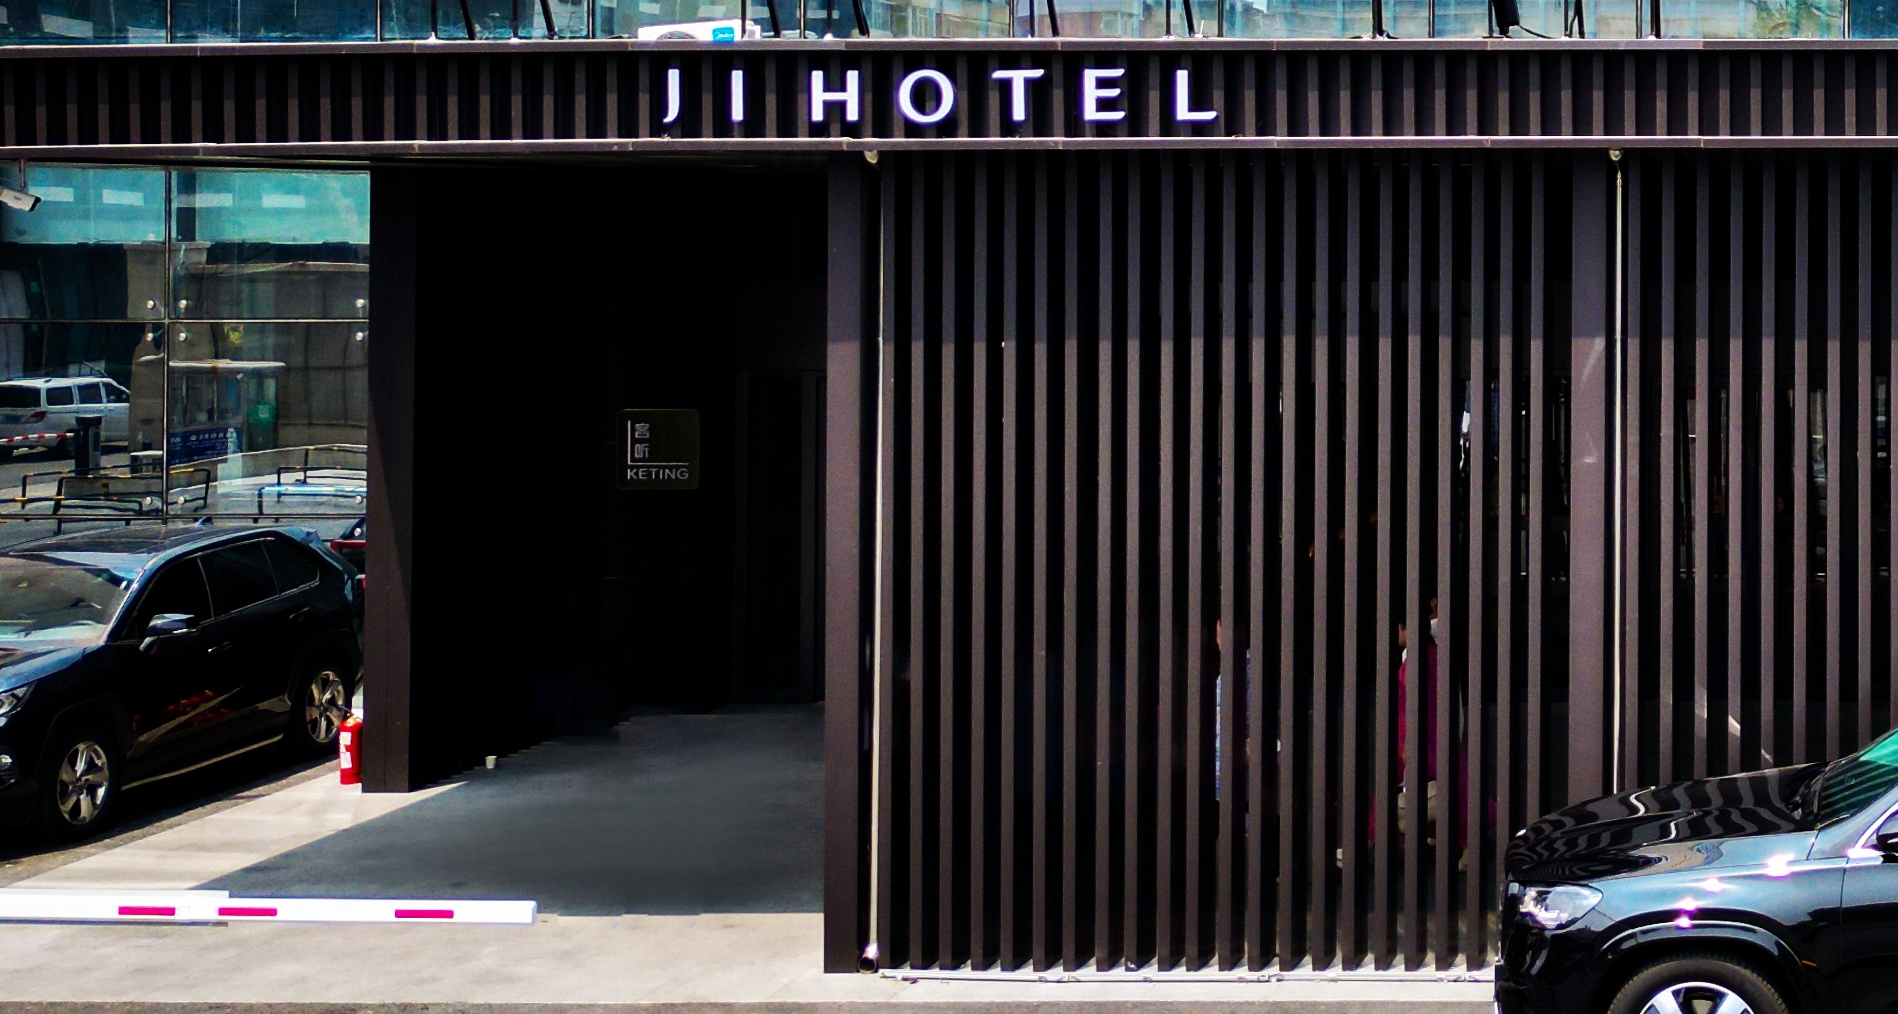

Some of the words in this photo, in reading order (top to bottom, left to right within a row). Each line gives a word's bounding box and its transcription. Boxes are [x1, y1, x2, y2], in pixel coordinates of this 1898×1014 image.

[664, 70, 744, 122] JI
[811, 69, 1217, 123] HOTEL
[627, 469, 689, 480] KETING
